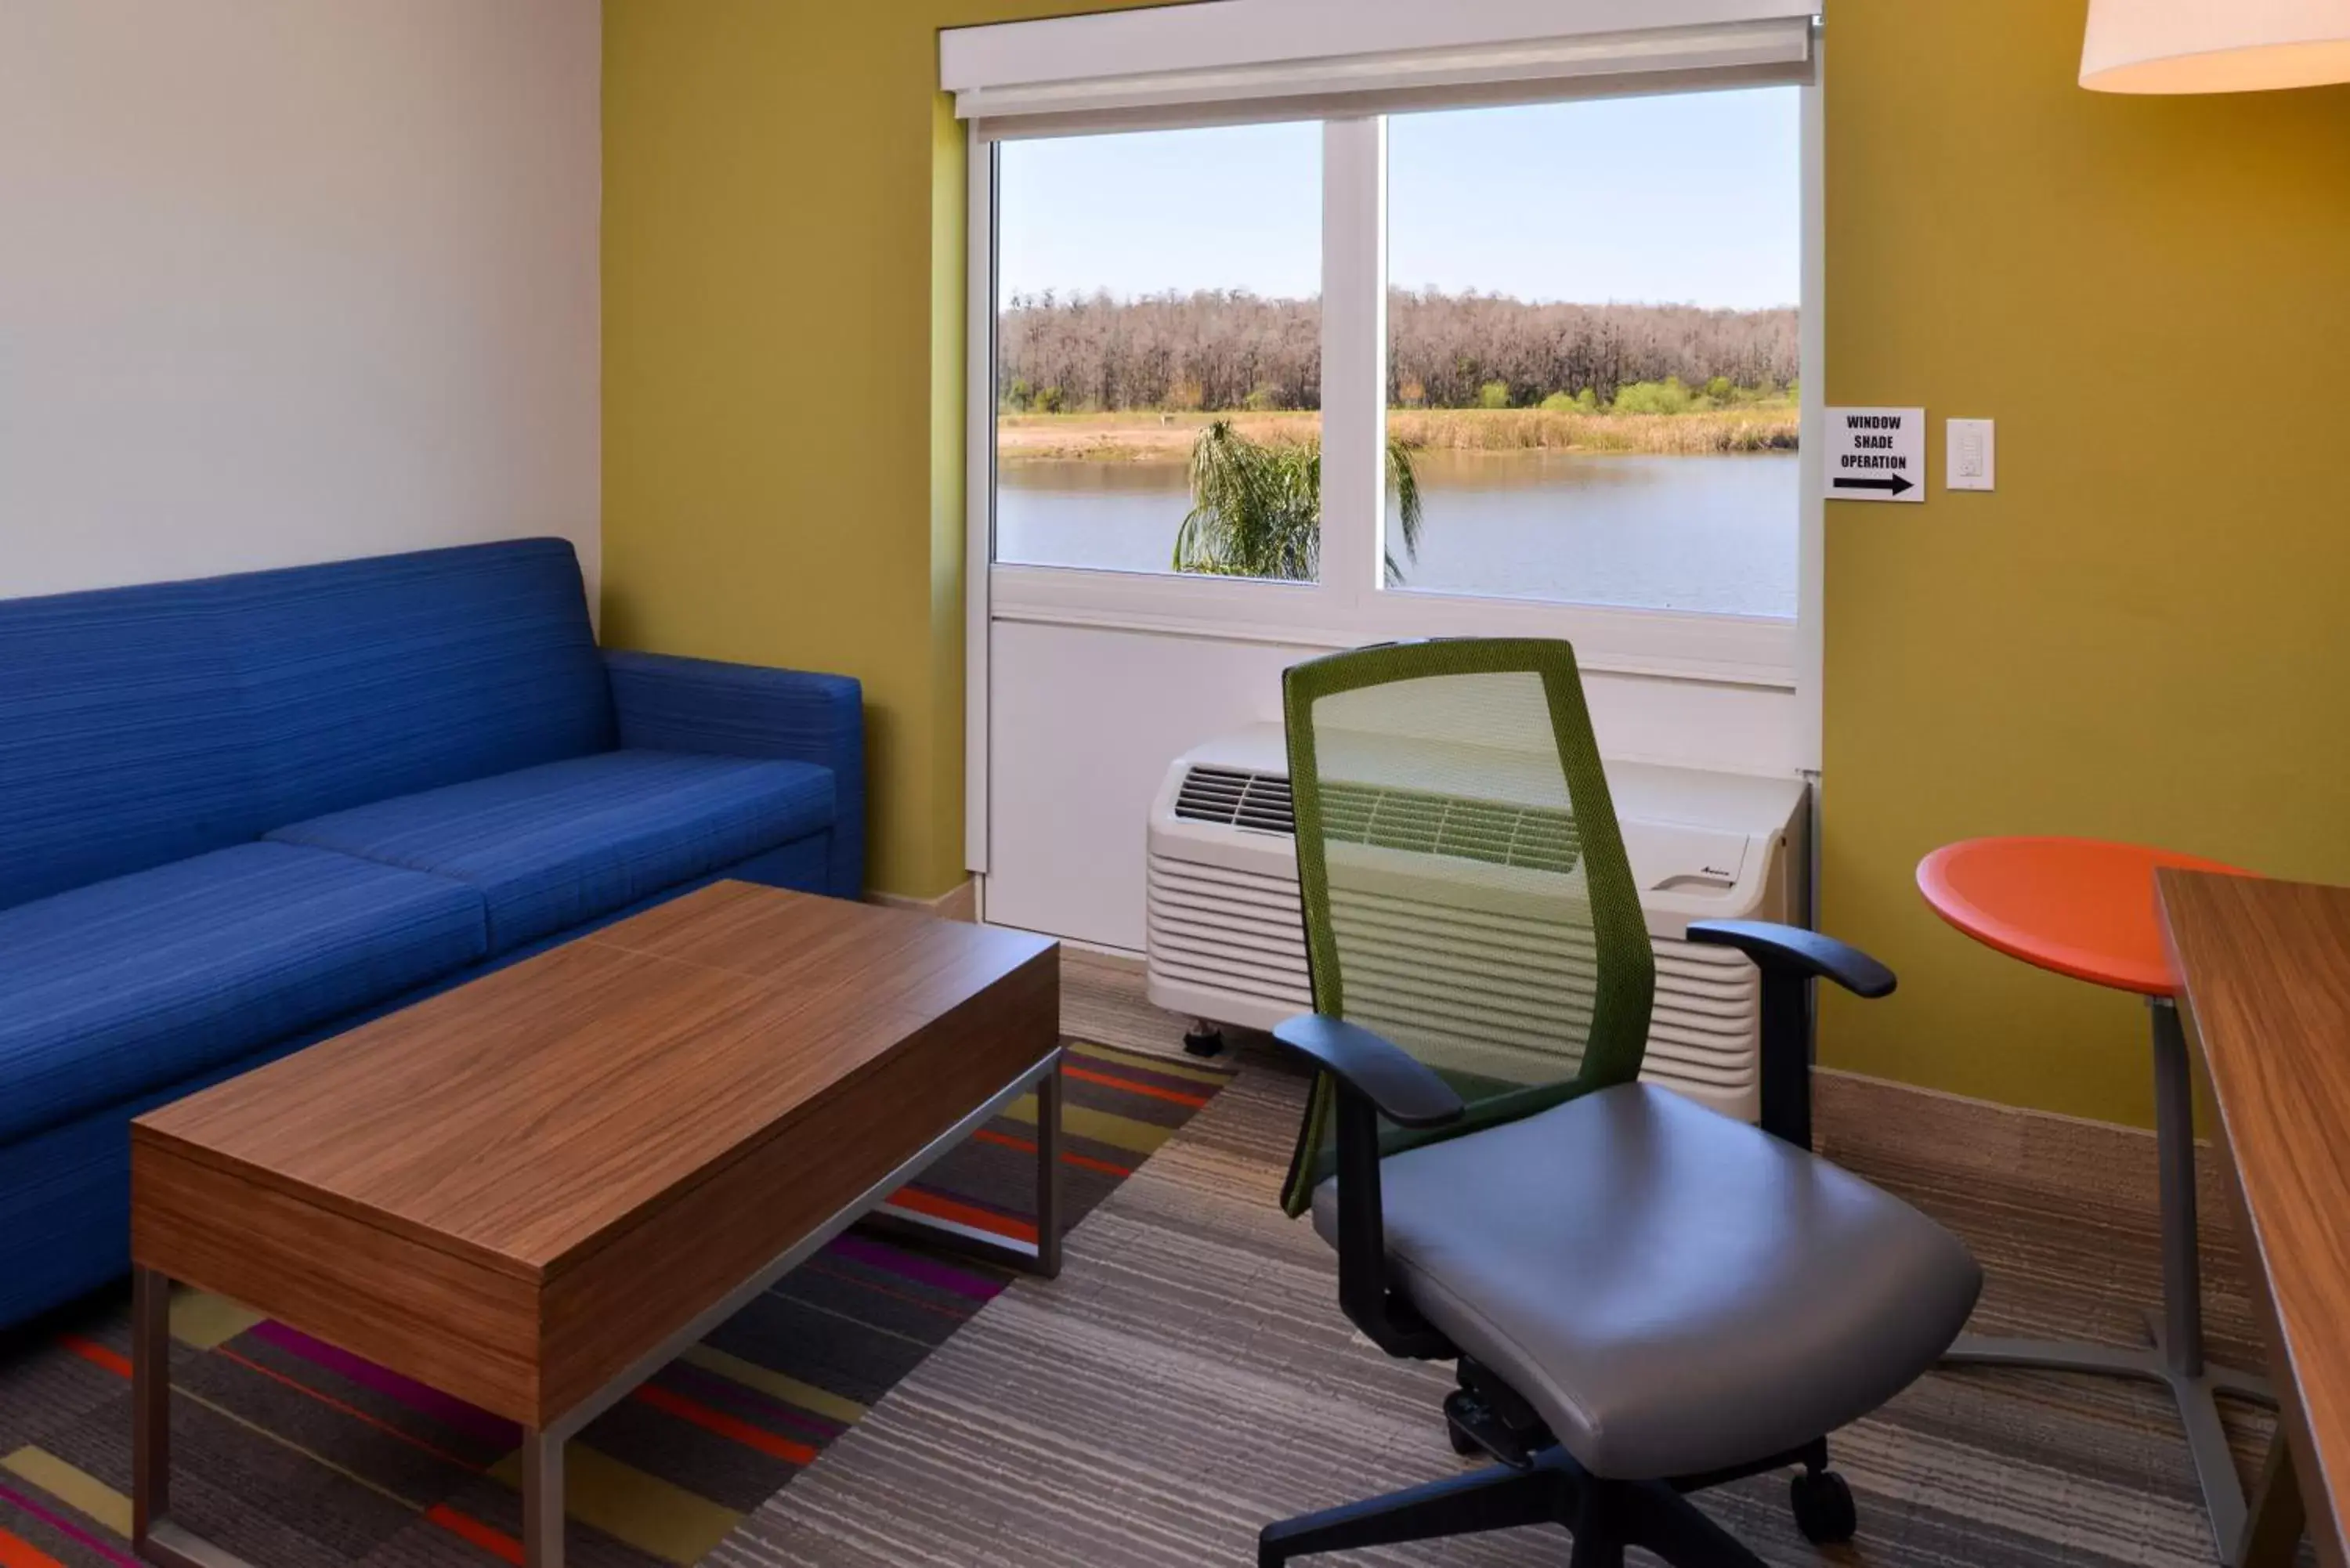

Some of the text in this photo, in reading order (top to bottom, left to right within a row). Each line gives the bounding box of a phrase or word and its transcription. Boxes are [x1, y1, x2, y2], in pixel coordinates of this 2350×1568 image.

[1846, 415, 1901, 430] WINDOW
[1854, 435, 1893, 449] SHADE
[1841, 455, 1907, 469] OPERATION
